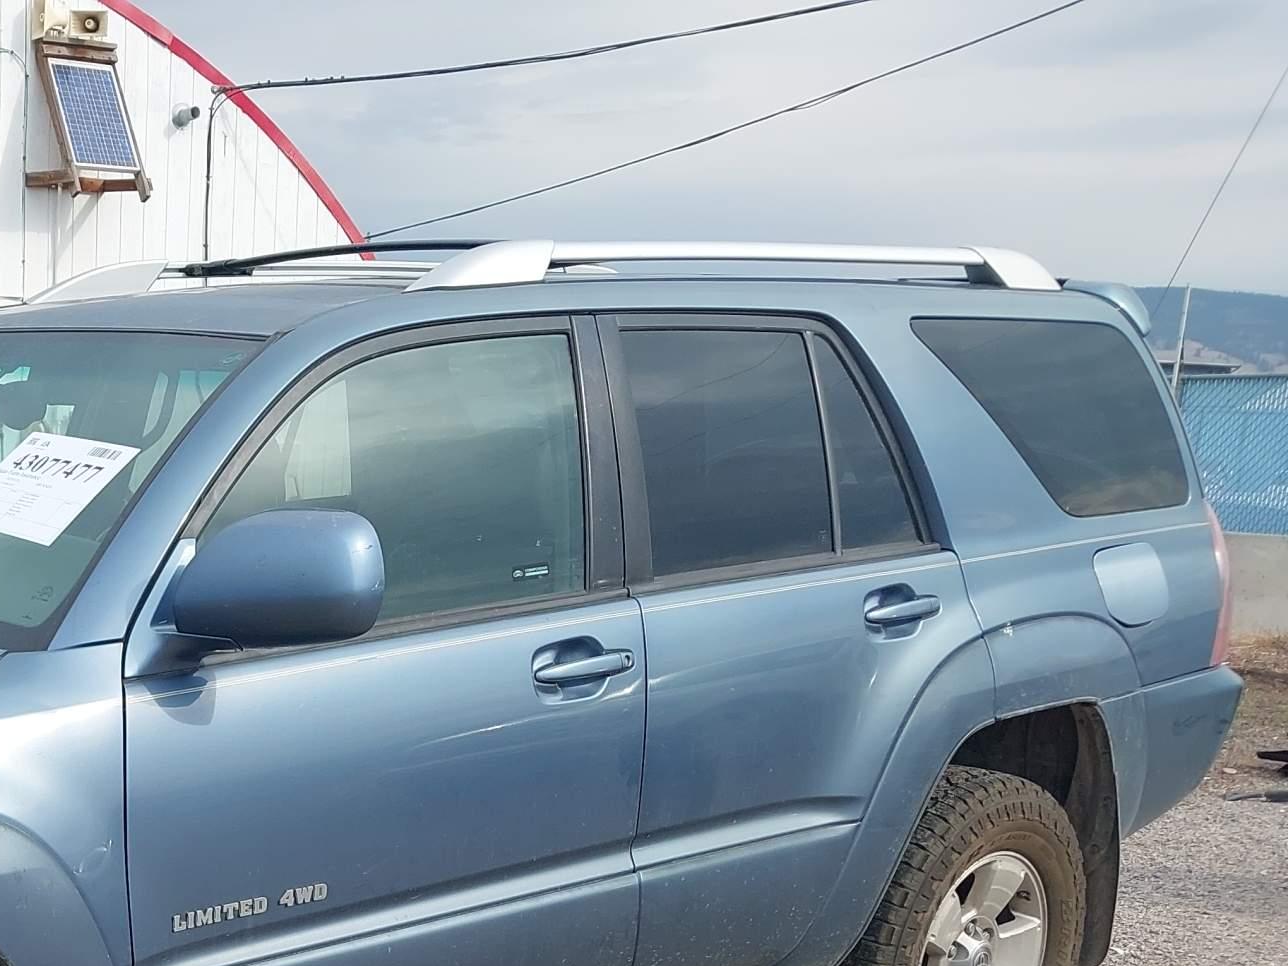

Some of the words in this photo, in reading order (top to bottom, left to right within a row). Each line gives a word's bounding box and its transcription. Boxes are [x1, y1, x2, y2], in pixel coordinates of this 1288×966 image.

[13, 453, 105, 484] 43077477
[172, 895, 269, 933] LIMITED
[278, 882, 329, 908] 4WD
